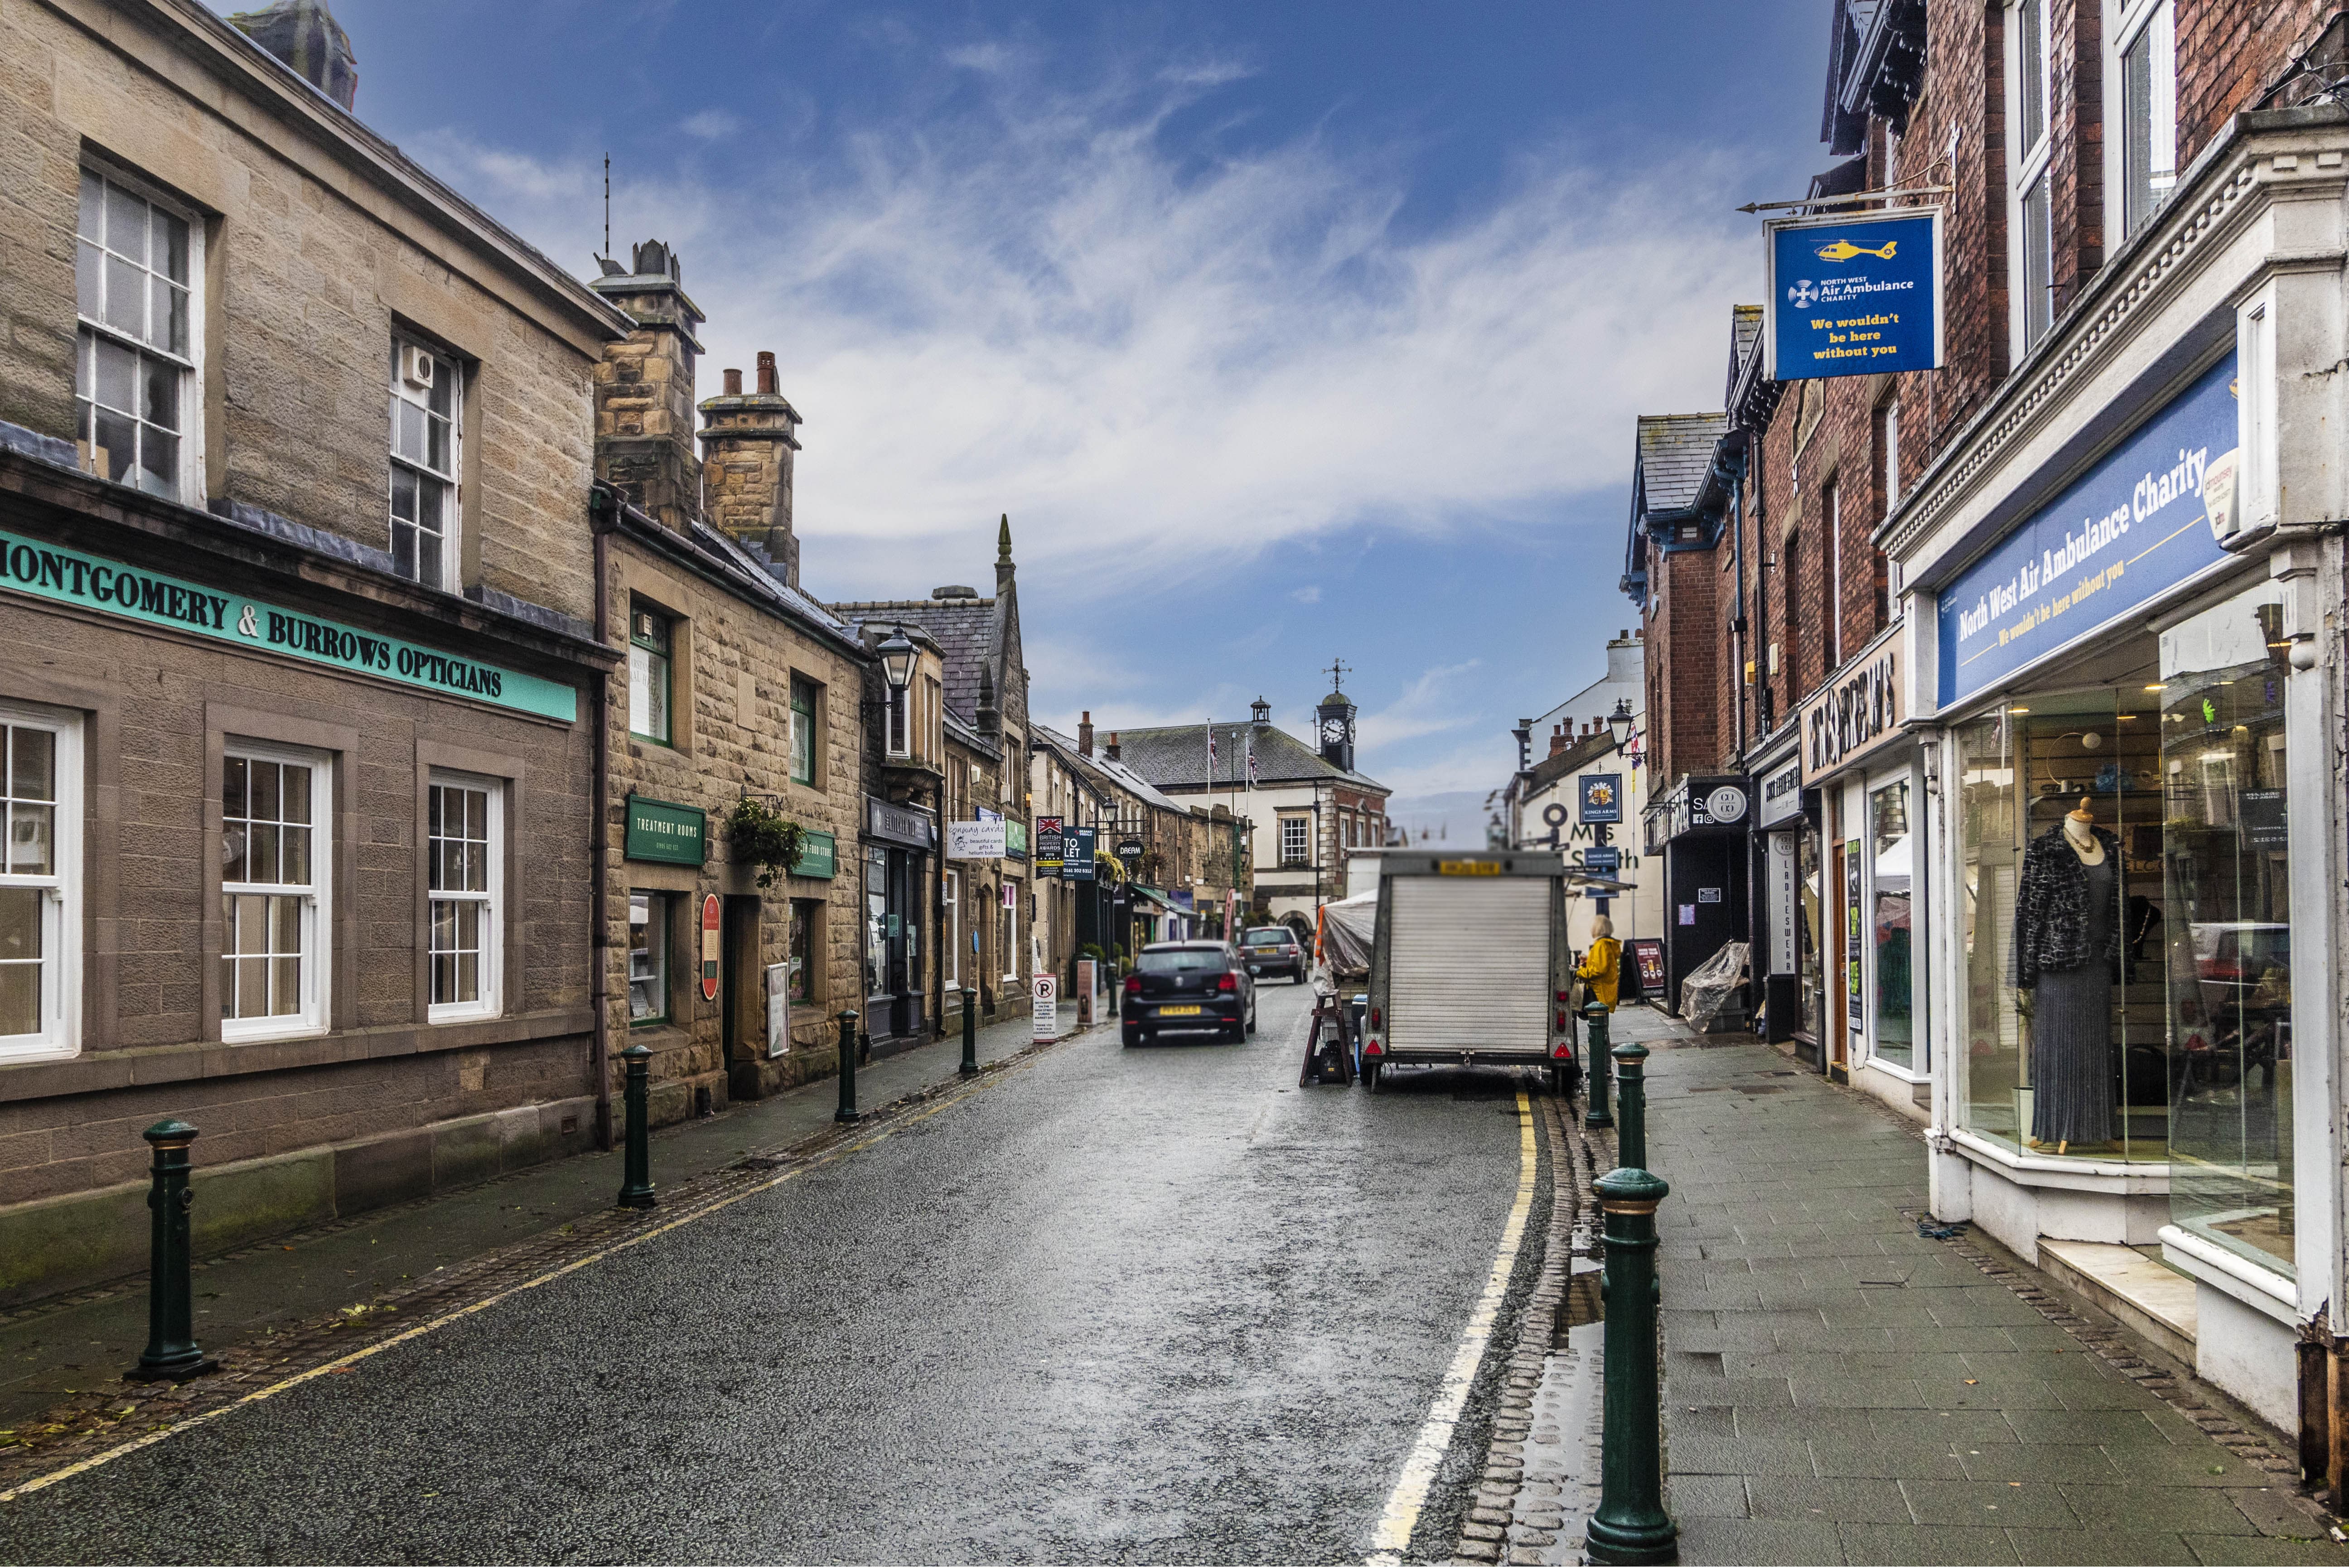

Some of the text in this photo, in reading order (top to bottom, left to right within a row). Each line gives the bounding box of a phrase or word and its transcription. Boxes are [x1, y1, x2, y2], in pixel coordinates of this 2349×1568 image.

[1821, 280, 1914, 296] Air Ambulance
[1821, 294, 1857, 302] CHARITY
[1811, 313, 1899, 330] We wouldn't
[1829, 331, 1881, 343] be here
[1813, 345, 1897, 359] without you
[1959, 594, 1988, 642] North
[1989, 577, 2017, 620] West
[2019, 565, 2039, 601] Air
[2041, 503, 2129, 587] Ambulance
[2133, 446, 2207, 523] Charity
[1998, 626, 2009, 647] We
[2040, 603, 2050, 622] be
[2052, 593, 2070, 618] here
[2071, 569, 2105, 605] without
[2106, 560, 2124, 590] you
[0, 540, 502, 698] ONTGOMERY & BURROWS OPTICIANS
[637, 818, 697, 838] TREATMENT ROOMS
[949, 824, 1005, 836] conway cards
[1064, 838, 1078, 848] TO
[821, 846, 831, 857] STORE
[1064, 848, 1080, 858] LET
[1120, 847, 1141, 855] DREAM
